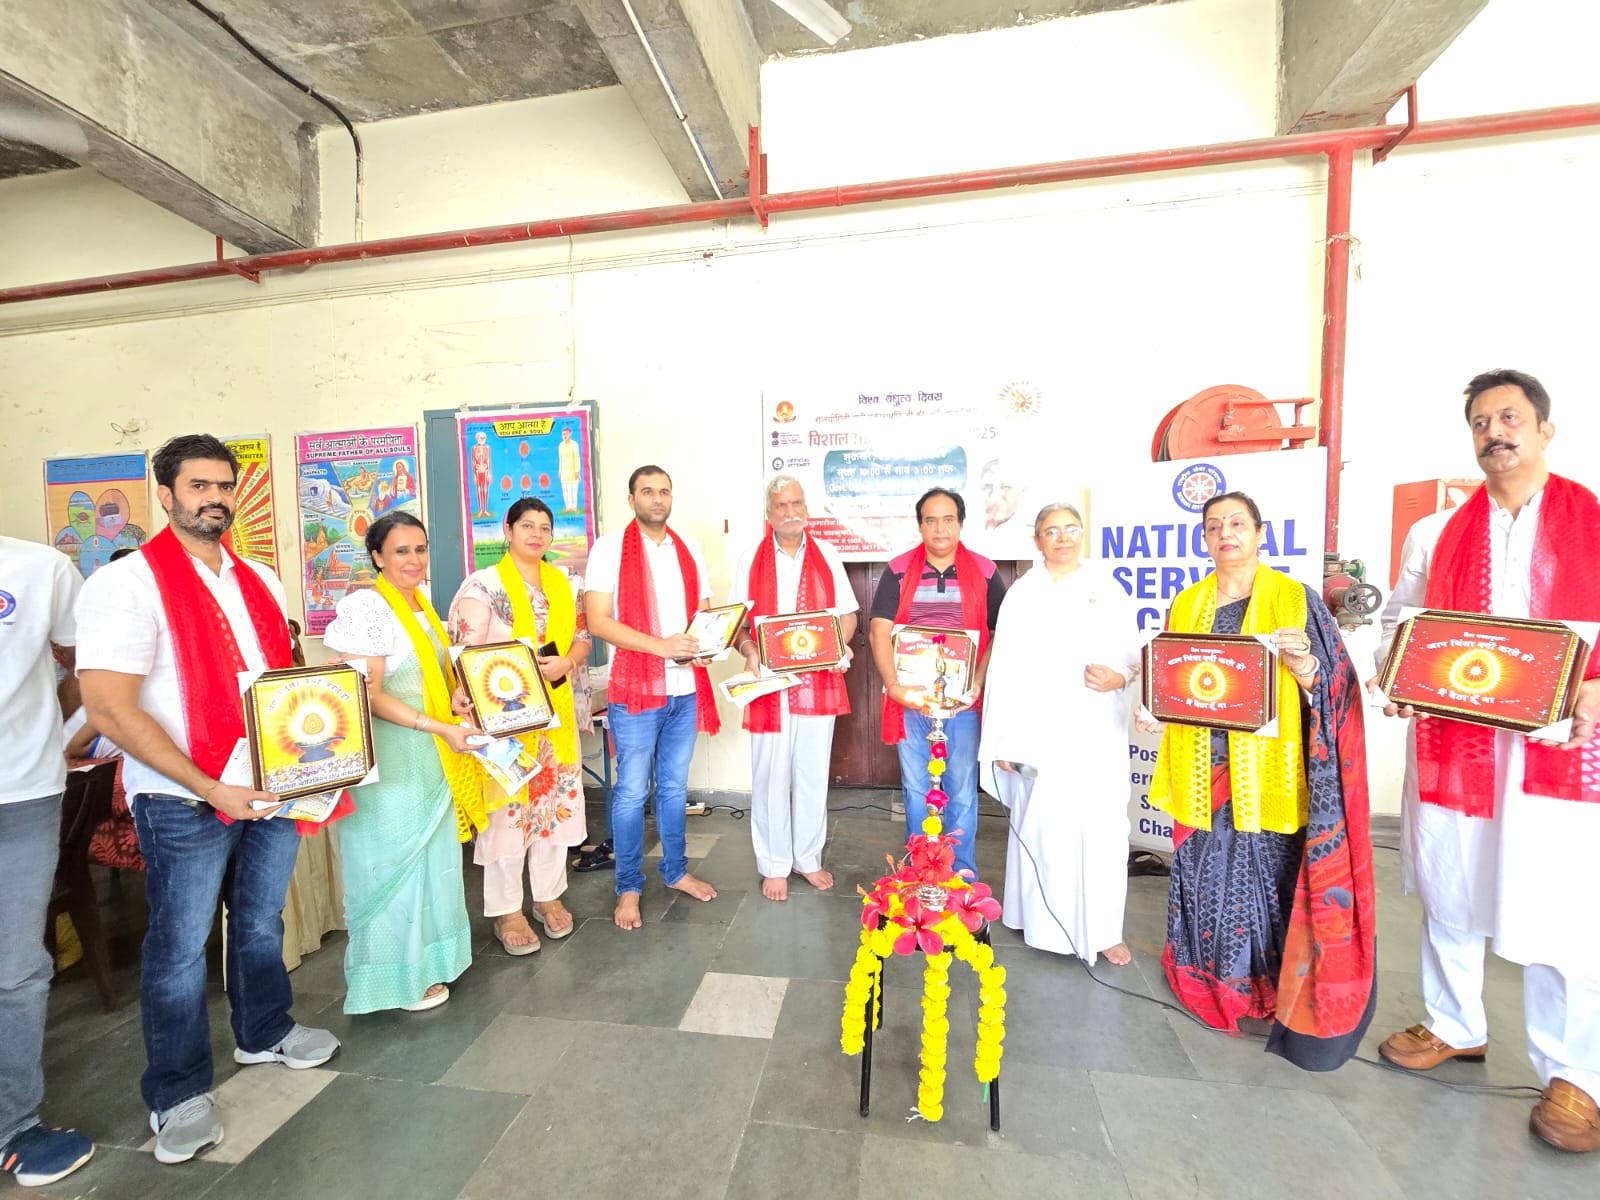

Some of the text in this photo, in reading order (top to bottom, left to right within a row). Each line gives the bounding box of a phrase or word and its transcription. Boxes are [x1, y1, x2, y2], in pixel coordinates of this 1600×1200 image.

[808, 430, 848, 447] विशाल
[306, 451, 337, 459] SUPREME
[338, 449, 363, 457] FATHER
